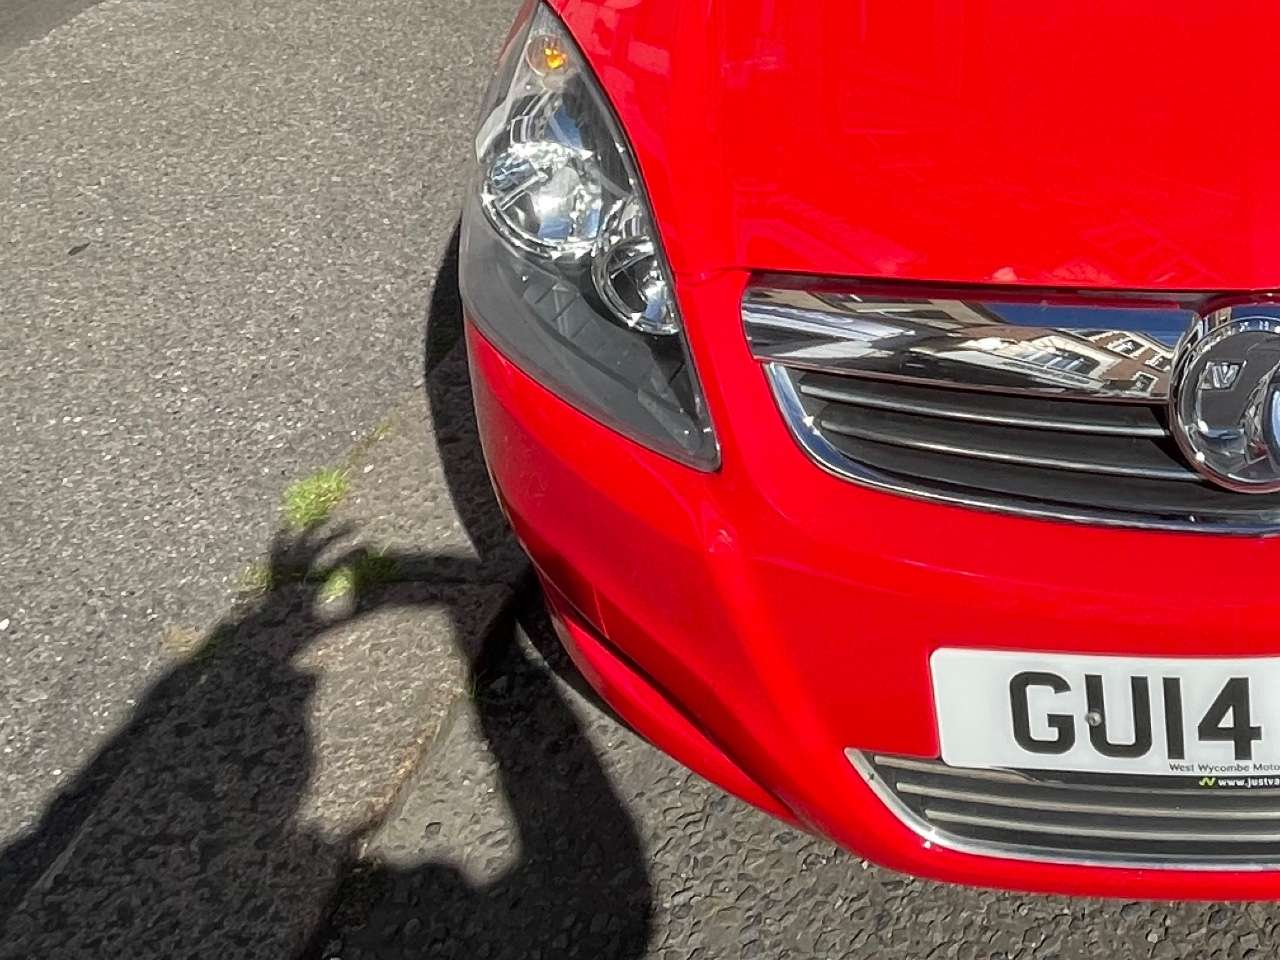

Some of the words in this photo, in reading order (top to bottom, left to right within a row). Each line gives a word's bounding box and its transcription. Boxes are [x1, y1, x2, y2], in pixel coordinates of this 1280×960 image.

[1008, 670, 1263, 761] GU14
[1169, 762, 1194, 772] West
[1199, 762, 1249, 773] Wycombe
